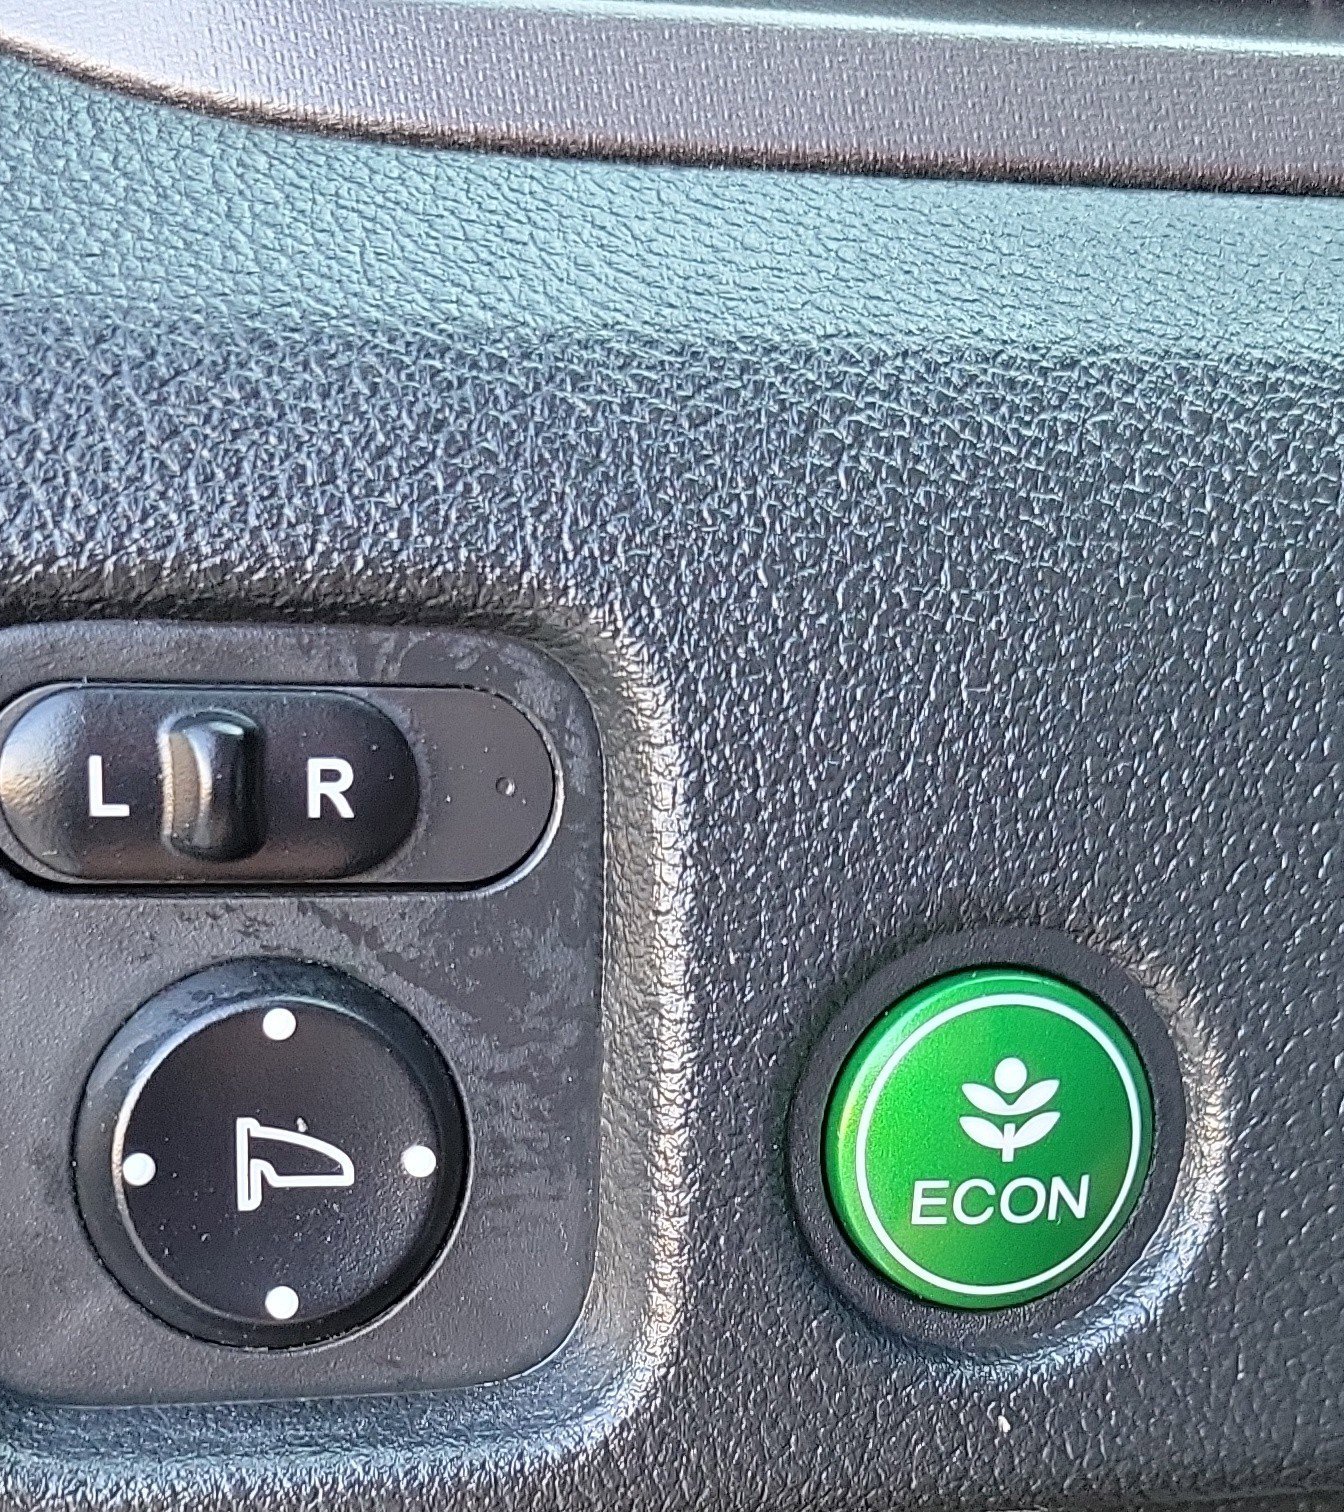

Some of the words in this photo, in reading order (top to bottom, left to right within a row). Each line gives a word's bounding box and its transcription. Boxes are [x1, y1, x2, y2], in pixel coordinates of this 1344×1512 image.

[88, 756, 130, 818] L
[306, 756, 355, 819] R
[911, 1175, 1090, 1226] ECON
